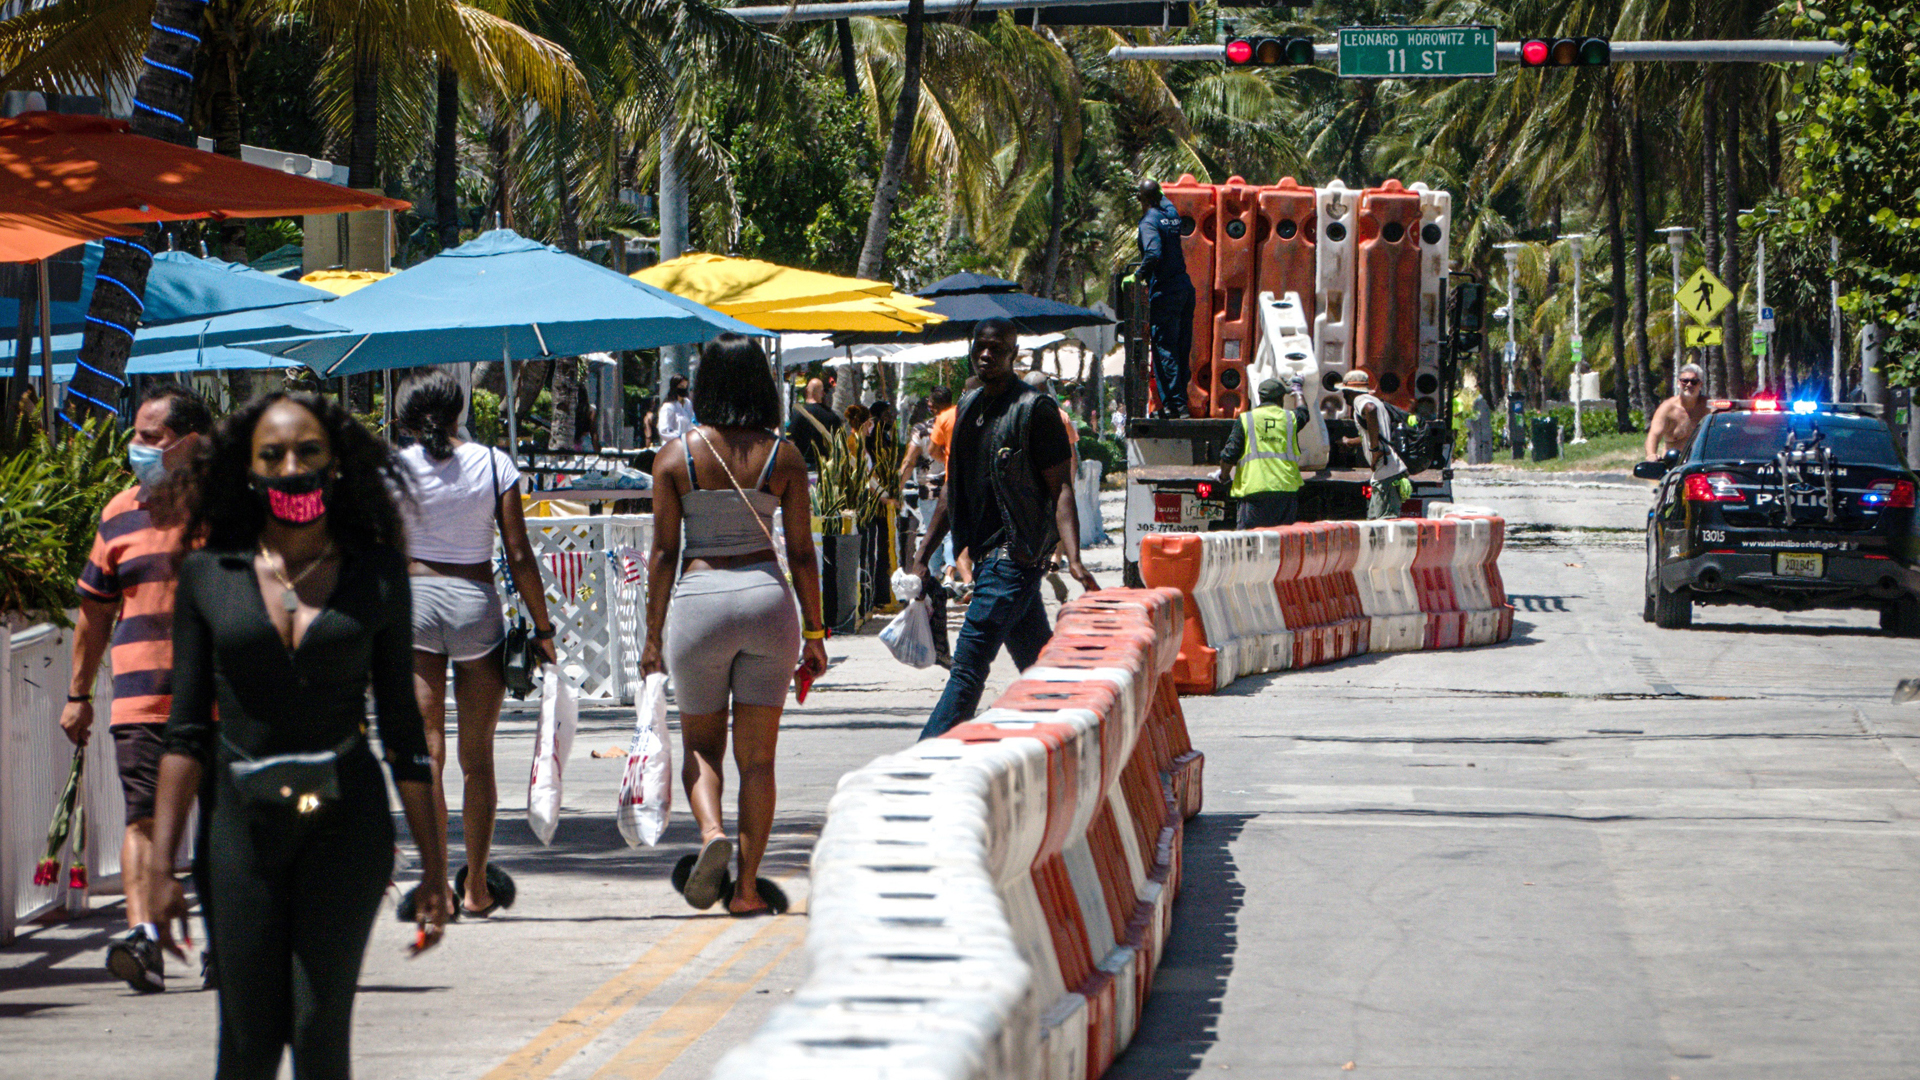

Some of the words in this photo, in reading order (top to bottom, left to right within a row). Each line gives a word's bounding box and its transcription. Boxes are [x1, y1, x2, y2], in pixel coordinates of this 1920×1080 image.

[1344, 33, 1398, 46] LEONARD
[1408, 33, 1465, 46] HOROWITZ
[1475, 33, 1490, 45] PL
[1388, 49, 1405, 72] 11
[1421, 50, 1446, 70] ST
[1757, 465, 1800, 475] MIMI
[1807, 466, 1847, 476] BEH
[1702, 530, 1726, 542] 13015
